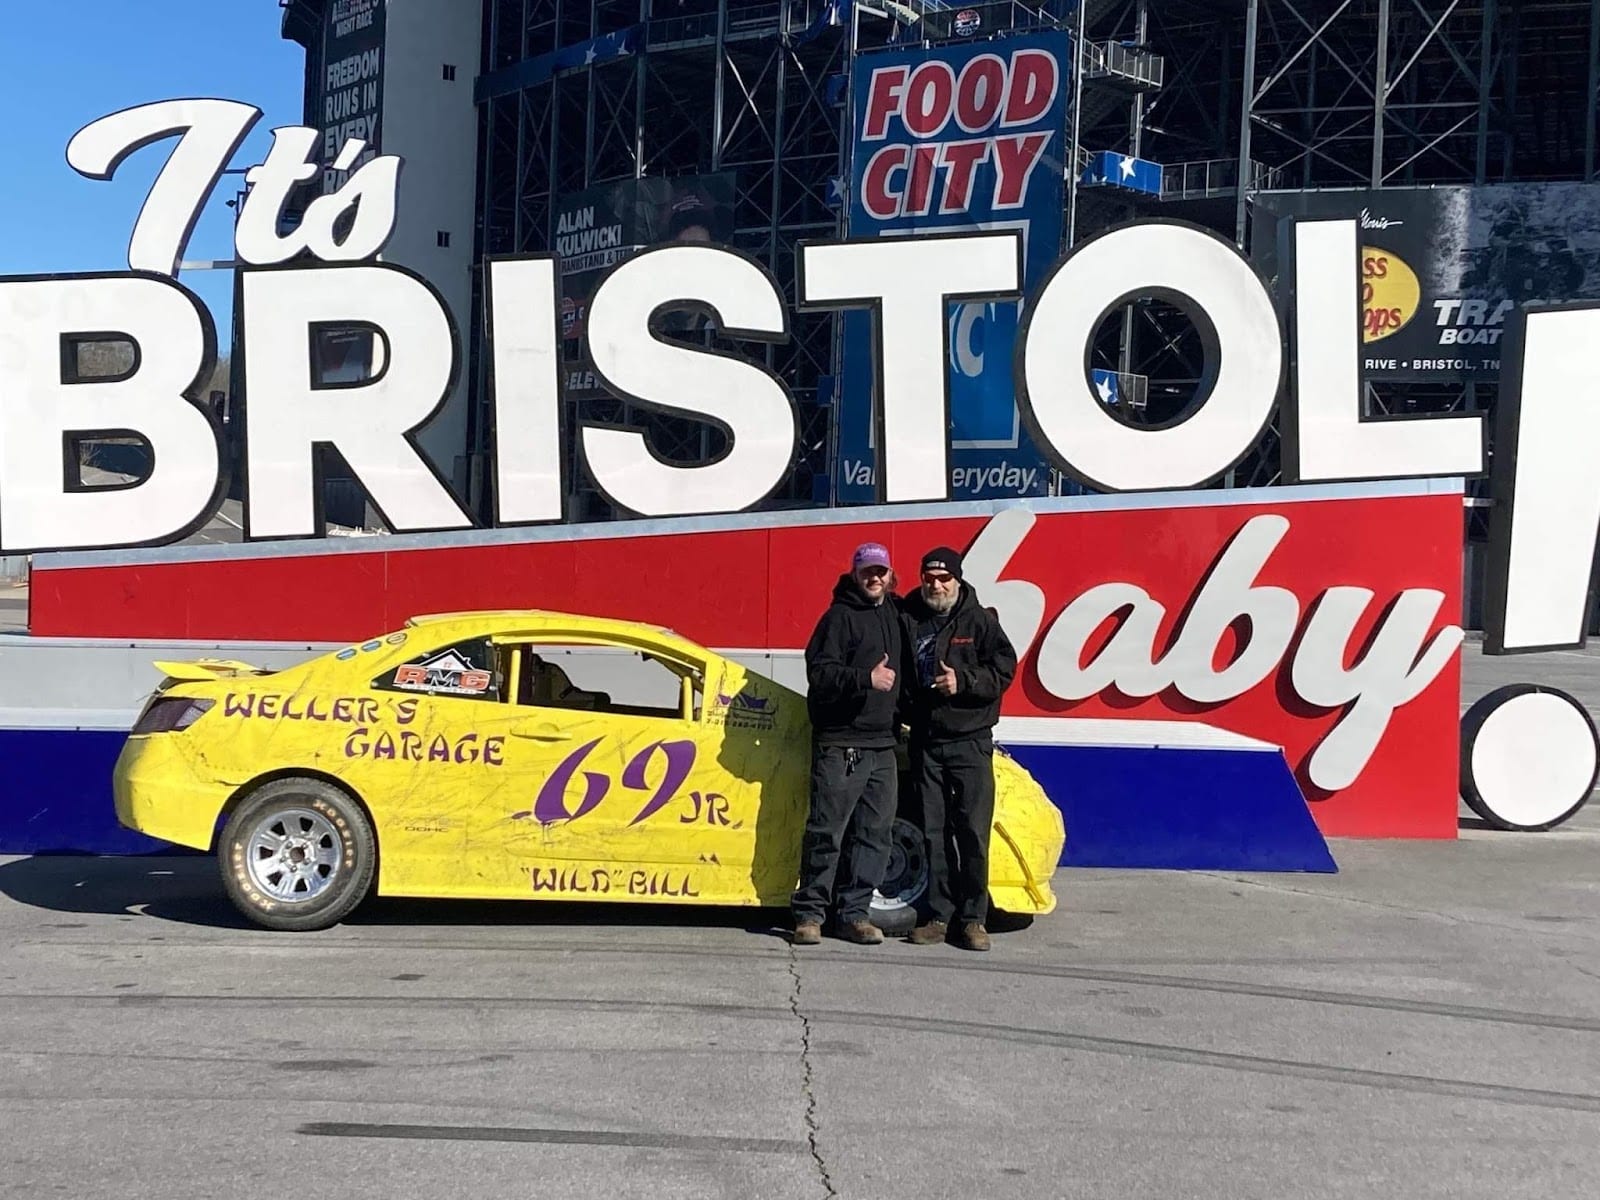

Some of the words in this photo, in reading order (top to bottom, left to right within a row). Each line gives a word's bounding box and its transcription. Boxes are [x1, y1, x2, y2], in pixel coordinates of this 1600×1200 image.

[327, 47, 379, 91] FREEDOM
[326, 87, 359, 122] RUNS
[363, 81, 377, 111] IN
[861, 49, 1059, 141] FOOD
[66, 97, 402, 278] It's
[861, 130, 1055, 220] CITY
[557, 206, 594, 234] ALAN
[557, 224, 622, 257] KULWICKI
[1364, 307, 1401, 337] ops
[1433, 299, 1514, 326] TRA
[1412, 359, 1477, 371] BRISTOL,
[1481, 359, 1500, 370] TN
[0, 219, 1483, 549] BRISTOL
[393, 663, 491, 690] RMG
[224, 692, 419, 724] WELLER'S
[345, 728, 506, 765] GARAGE
[533, 735, 697, 829] 69
[628, 870, 700, 897] BILL
